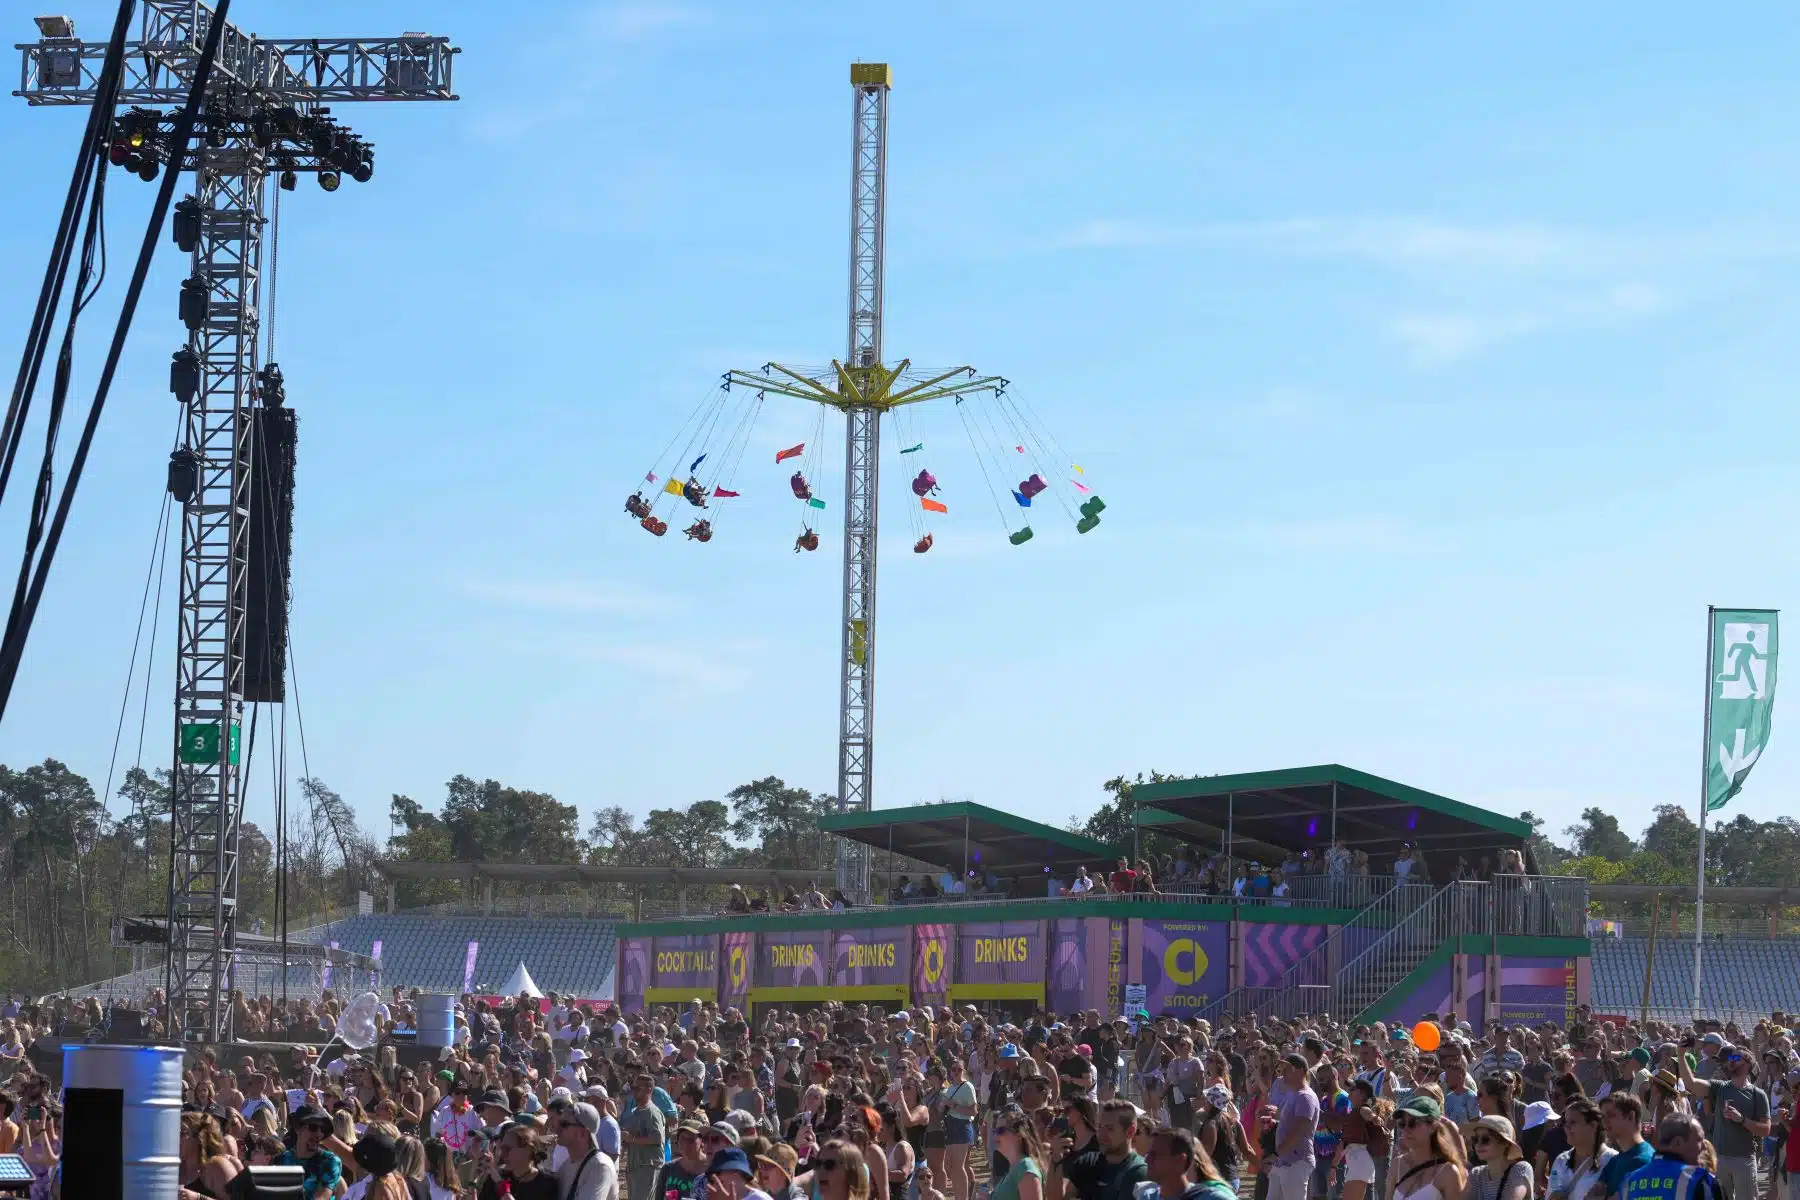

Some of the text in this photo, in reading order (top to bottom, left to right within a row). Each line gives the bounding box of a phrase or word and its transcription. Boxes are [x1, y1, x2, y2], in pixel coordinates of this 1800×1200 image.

[194, 736, 205, 750] 3
[771, 943, 814, 968] DRINKS
[848, 943, 896, 968] DRINKS
[974, 936, 1027, 963] DRINKS
[656, 951, 715, 973] COCKTAILS
[1163, 993, 1209, 1007] smart
